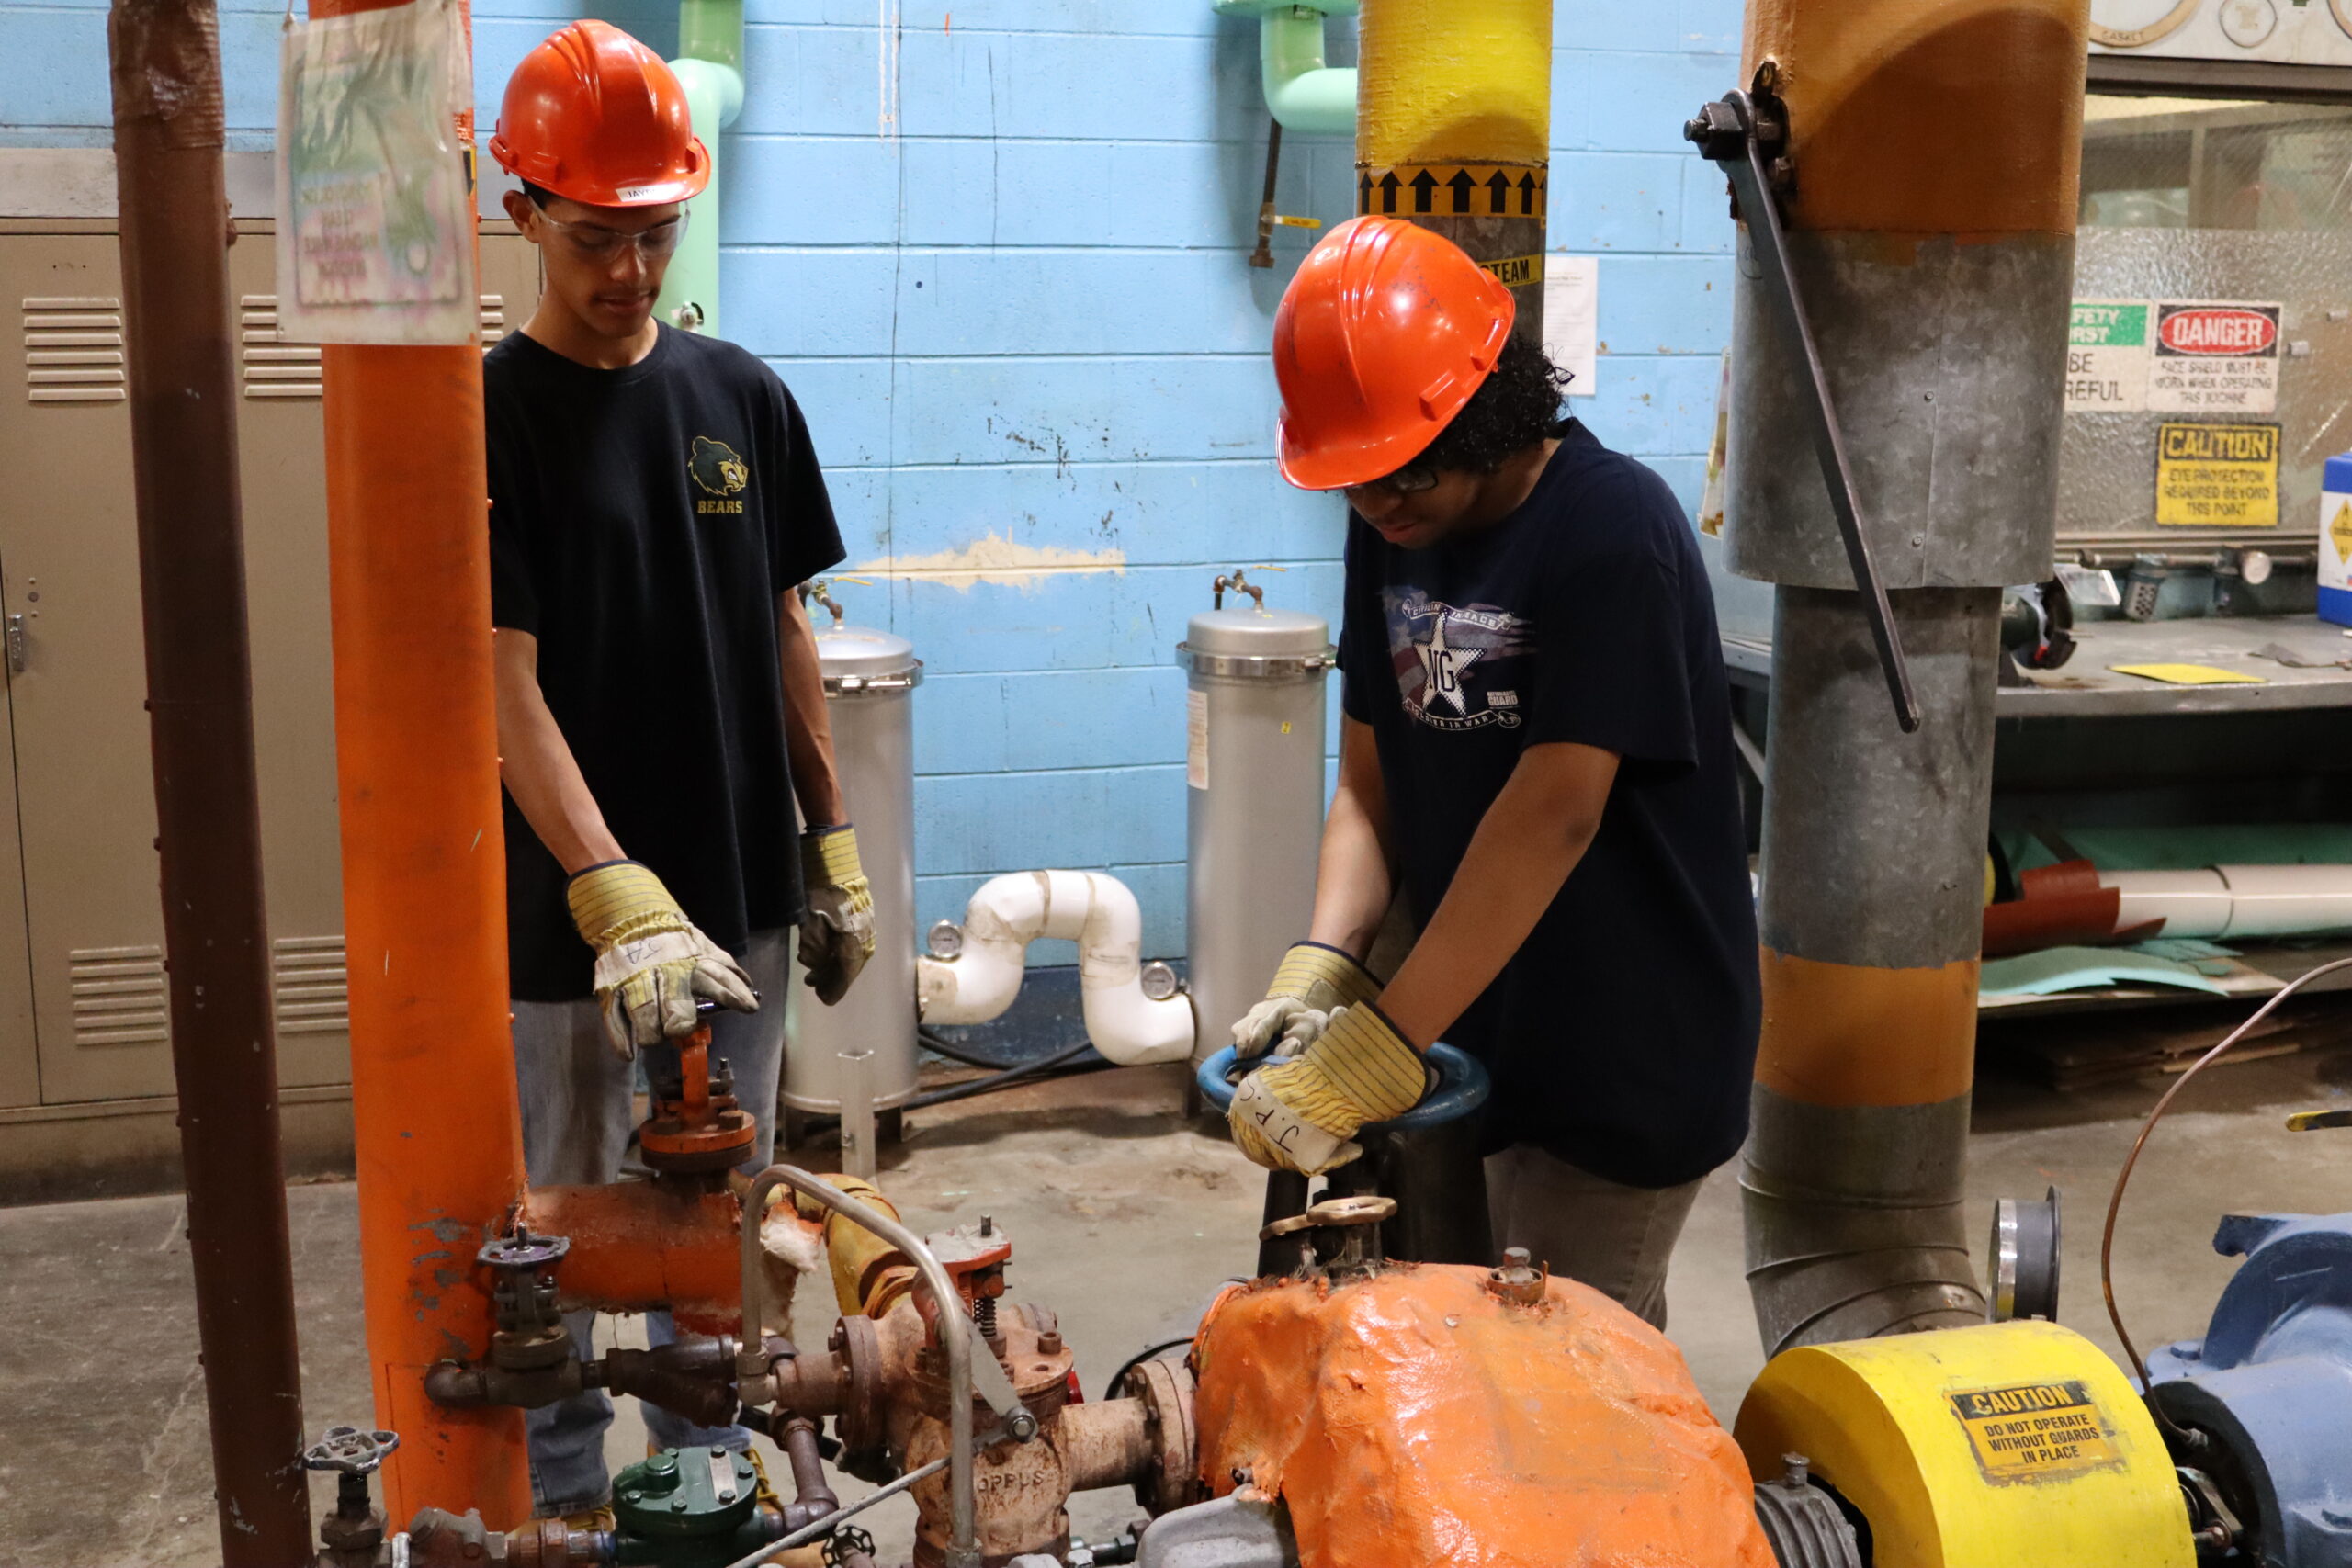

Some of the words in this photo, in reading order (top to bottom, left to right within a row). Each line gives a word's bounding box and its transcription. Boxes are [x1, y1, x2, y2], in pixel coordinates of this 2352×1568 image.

[2071, 308, 2120, 325] FETY
[2173, 317, 2264, 346] DANGER
[2068, 353, 2094, 373] BE
[2064, 380, 2124, 400] REFUL
[2166, 430, 2270, 458] CAUTION
[2169, 468, 2190, 482] EYE
[2194, 468, 2265, 483] PROTECTION
[2165, 486, 2220, 499] REQUIRED
[2222, 487, 2269, 499] BEYOND
[697, 501, 742, 513] BEARS
[2187, 502, 2210, 515] THIS
[2214, 502, 2247, 515] POINT
[1427, 649, 1455, 692] NG
[1488, 695, 1518, 705] GUARD
[1464, 715, 1488, 727] WAR
[1971, 1384, 2074, 1416] CAUTION
[1984, 1424, 2003, 1437] DO
[2007, 1421, 2031, 1433] NOT
[2033, 1413, 2090, 1431] OPERATE
[1988, 1433, 2047, 1452] WITHOUT
[2050, 1427, 2099, 1445] GUARDS
[2021, 1450, 2038, 1463] IN
[2041, 1445, 2081, 1462] PLACE
